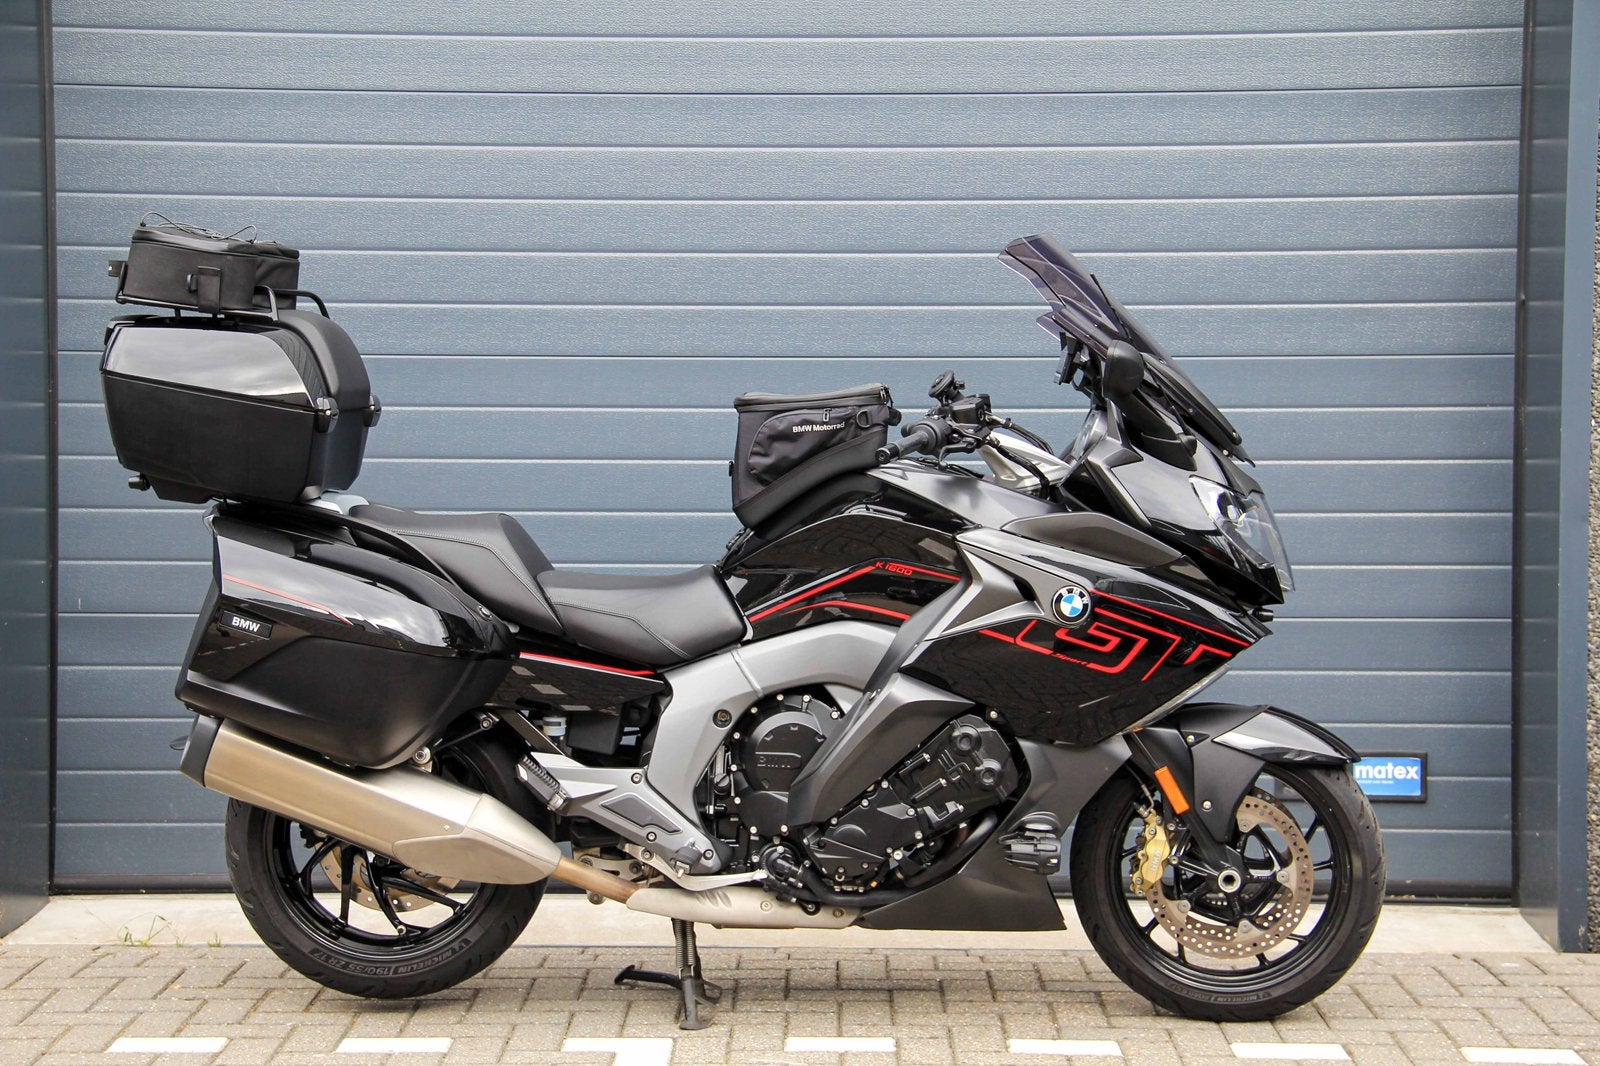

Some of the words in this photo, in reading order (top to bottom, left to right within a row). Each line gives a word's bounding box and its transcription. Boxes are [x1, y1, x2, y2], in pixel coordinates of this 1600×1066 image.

[792, 424, 812, 433] BMW
[813, 421, 845, 432] Motorrad
[875, 561, 886, 569] K
[885, 563, 913, 576] 1600
[231, 616, 261, 632] BMW
[1354, 762, 1419, 779] matex
[397, 949, 453, 974] MICHELIN
